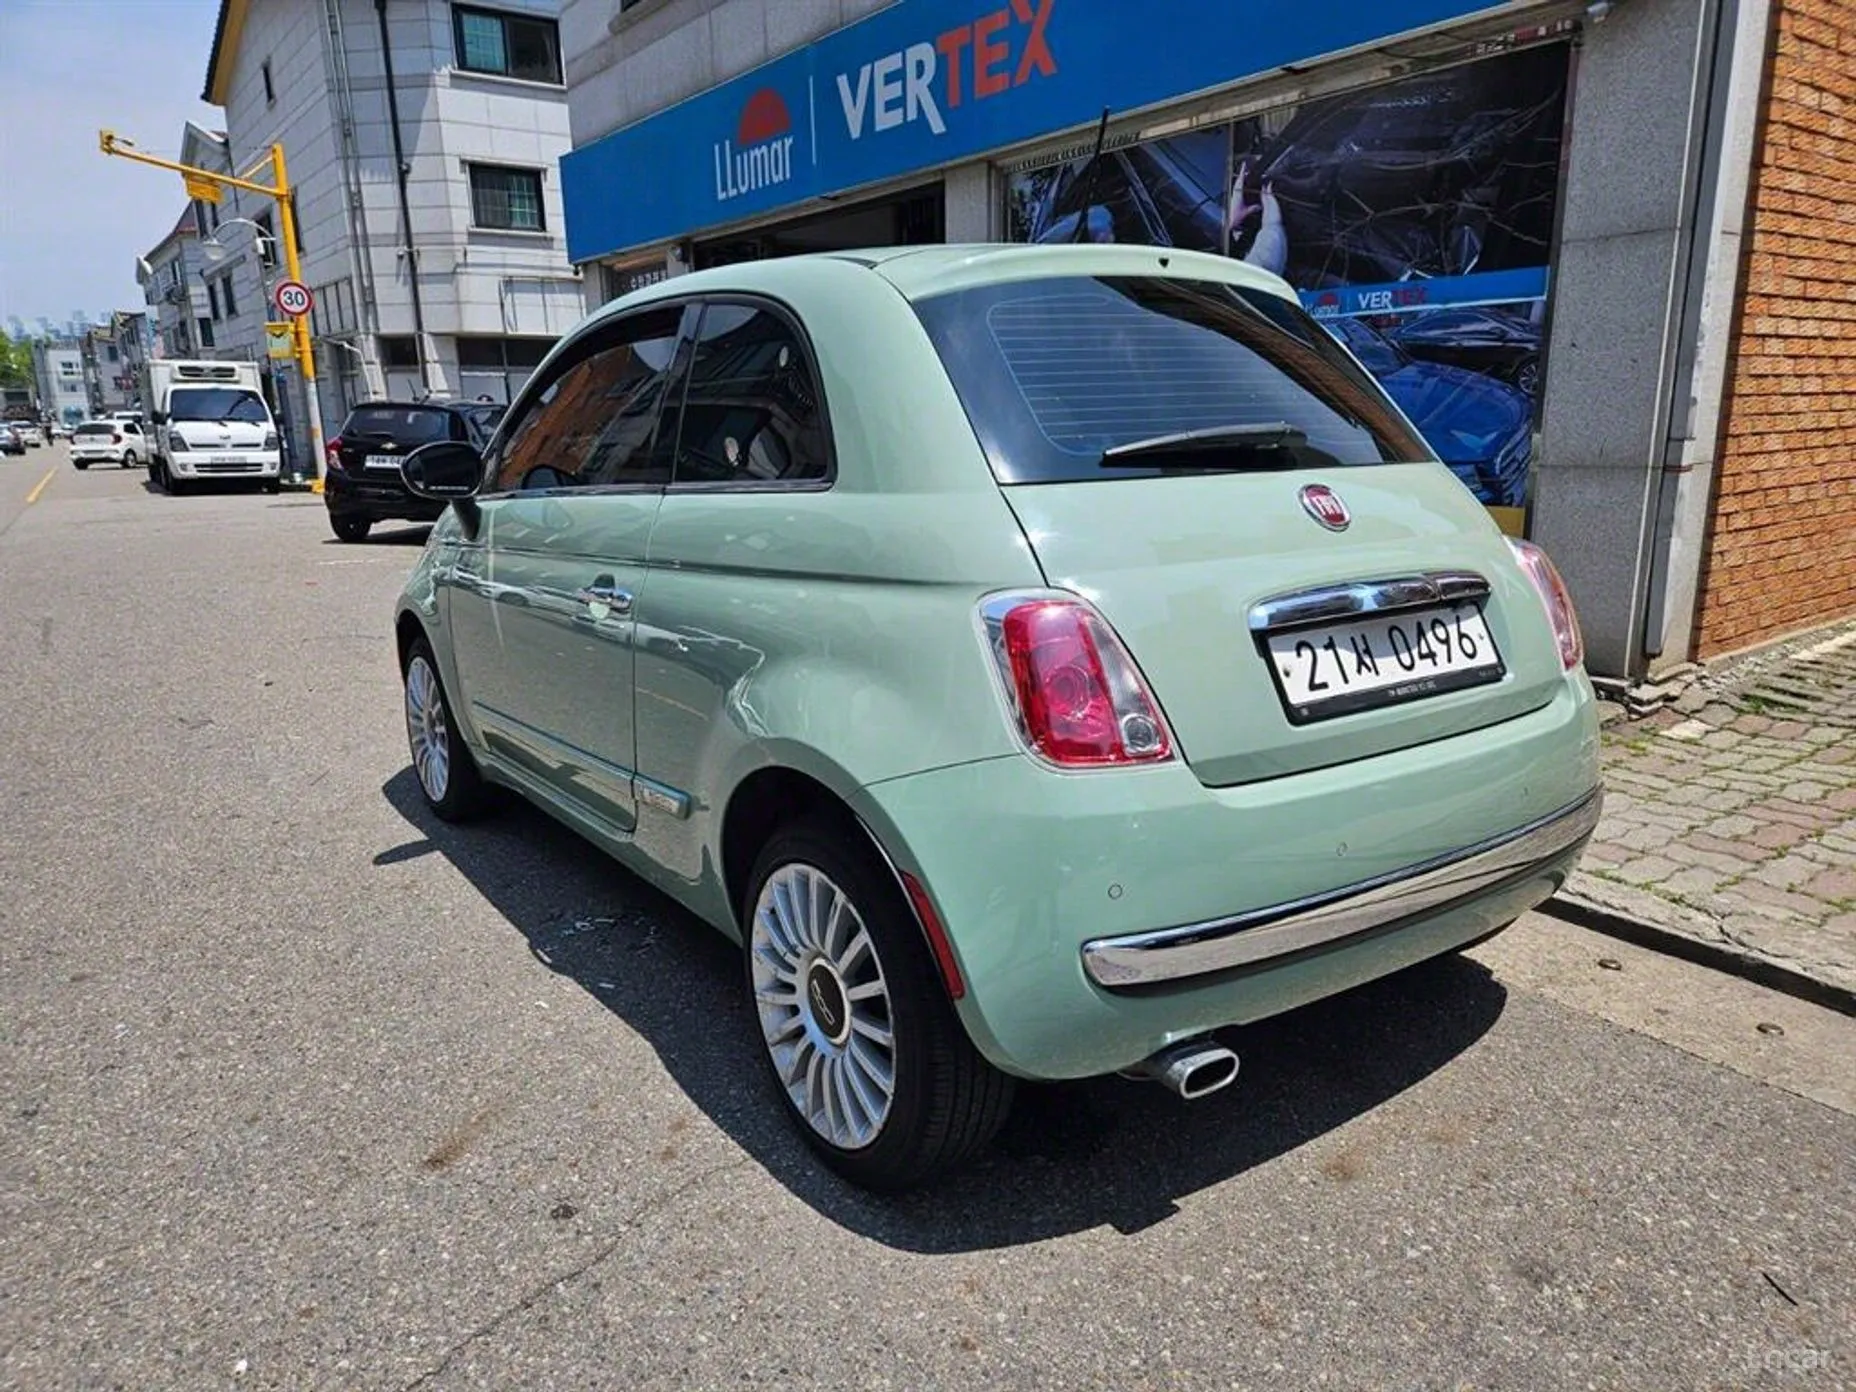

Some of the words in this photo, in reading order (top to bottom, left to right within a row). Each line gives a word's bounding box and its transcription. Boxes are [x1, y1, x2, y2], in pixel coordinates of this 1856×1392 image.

[714, 136, 793, 200] LLumar
[836, 0, 1058, 140] VERTEX
[283, 290, 305, 306] 30
[1296, 633, 1380, 692] 21서
[1387, 614, 1478, 672] 0496
